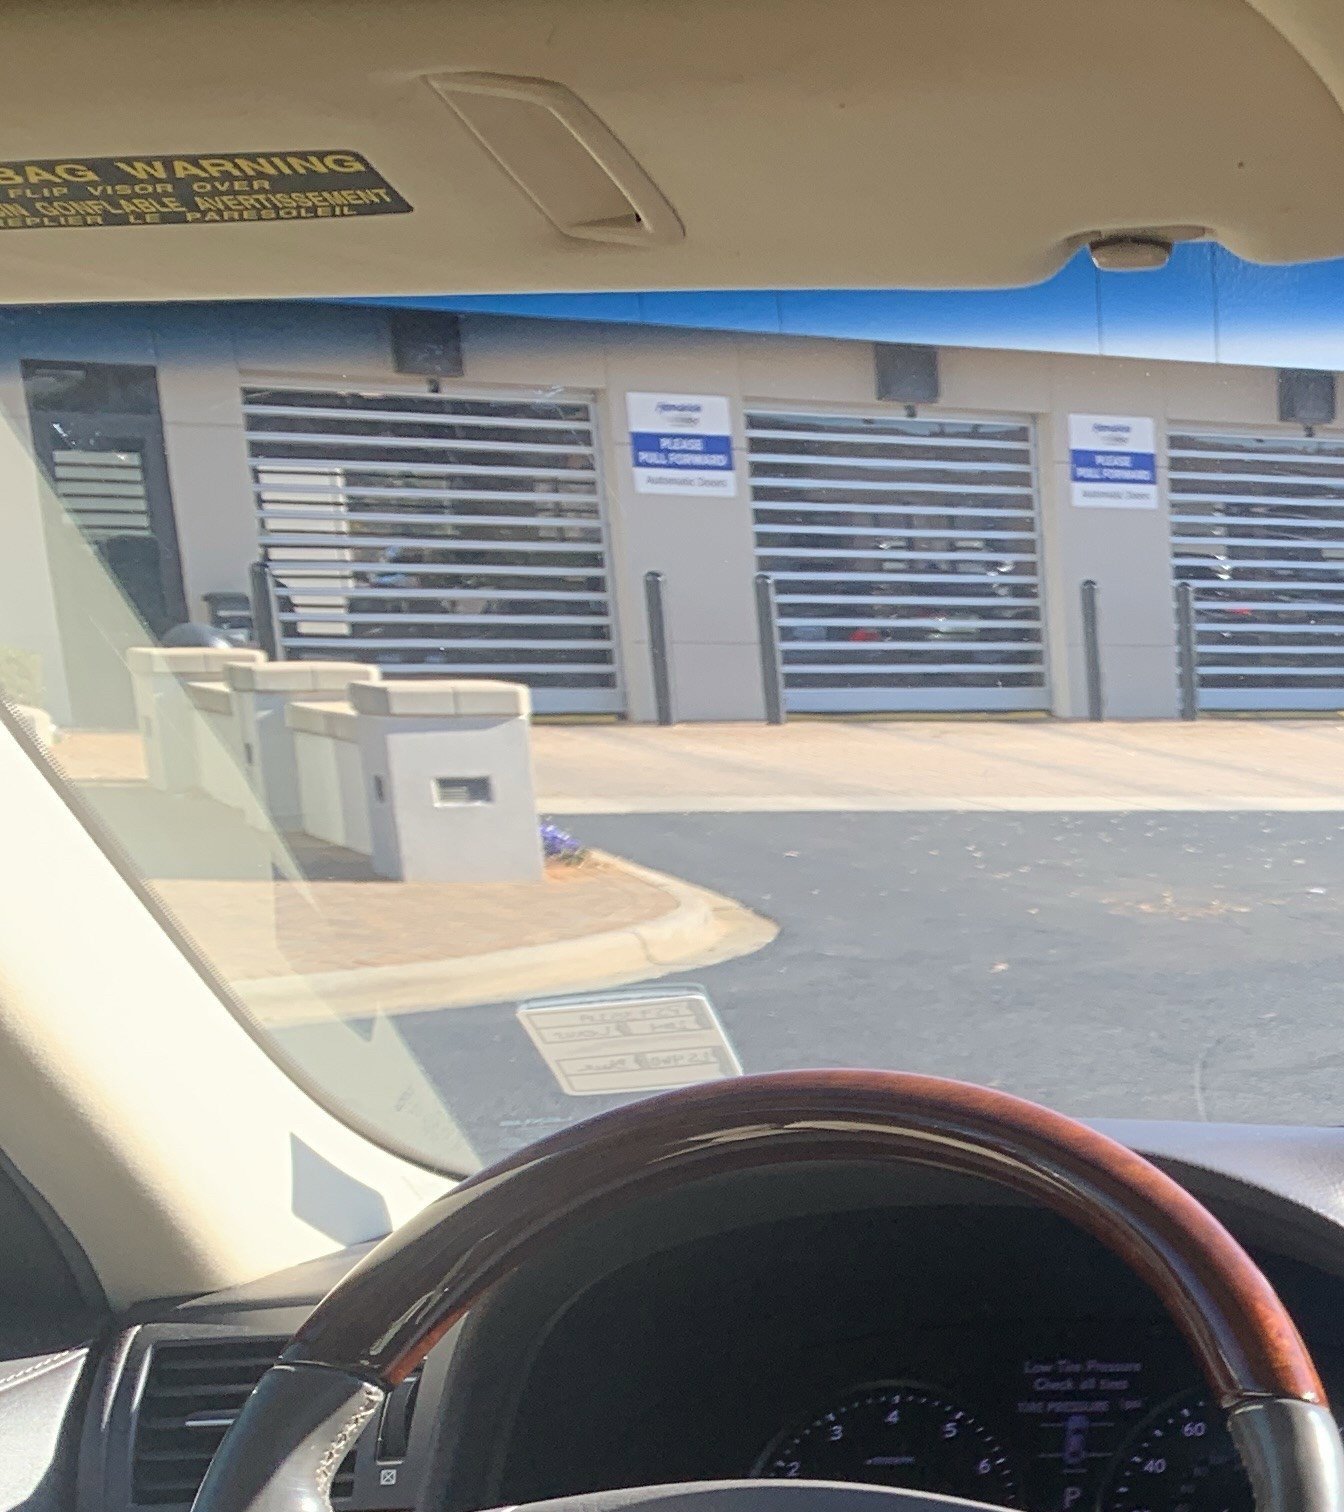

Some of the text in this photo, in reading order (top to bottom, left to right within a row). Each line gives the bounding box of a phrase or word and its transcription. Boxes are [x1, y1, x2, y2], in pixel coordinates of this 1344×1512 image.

[114, 153, 366, 180] WARNING
[8, 179, 271, 200] FLIP VISOR OVER
[35, 197, 189, 217] GONFLABLE
[194, 187, 392, 212] AVERTISSEMENT
[0, 214, 104, 228] EPLIER
[129, 212, 161, 225] LE
[885, 1408, 900, 1424] 4
[829, 1424, 843, 1441] 3
[943, 1421, 958, 1439] 5
[1182, 1421, 1207, 1437] 60
[785, 1460, 801, 1477] 2
[976, 1458, 991, 1474] 6
[1143, 1457, 1167, 1474] 40
[1063, 1485, 1082, 1509] P
